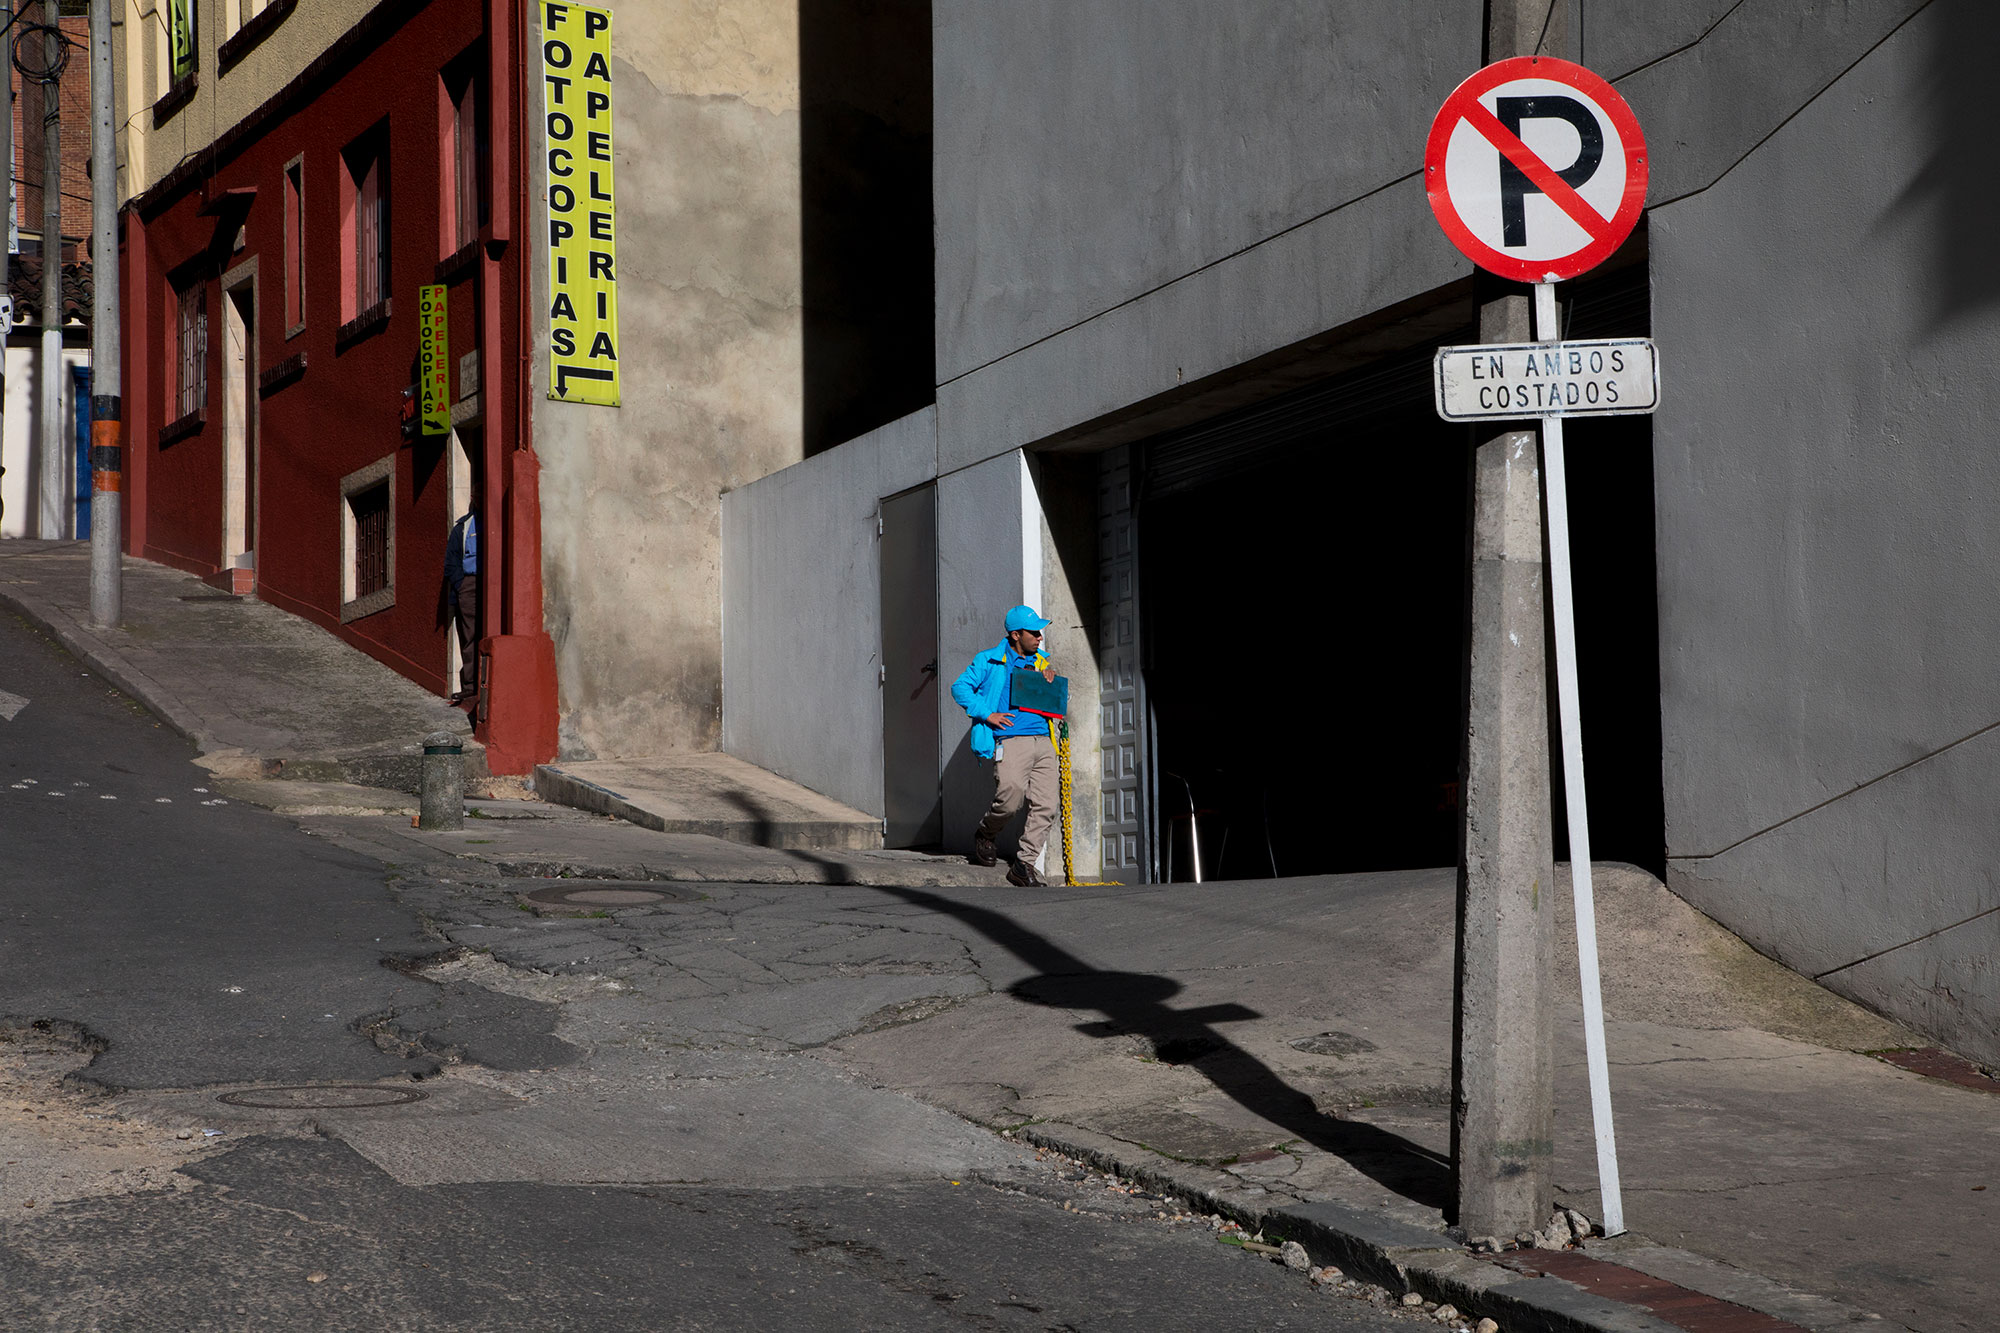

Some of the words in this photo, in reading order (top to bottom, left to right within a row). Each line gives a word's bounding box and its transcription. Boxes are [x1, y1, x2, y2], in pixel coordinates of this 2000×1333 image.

[543, 3, 577, 357] FOTOCOPIAS
[584, 11, 617, 361] PAPELERIA
[1497, 95, 1603, 247] P
[421, 288, 433, 414] FOTOCOPIAS
[434, 287, 446, 413] PAPELERIA
[1471, 354, 1505, 380] EN
[1525, 349, 1625, 378] AMBOS
[1479, 380, 1620, 409] COSTADOS
